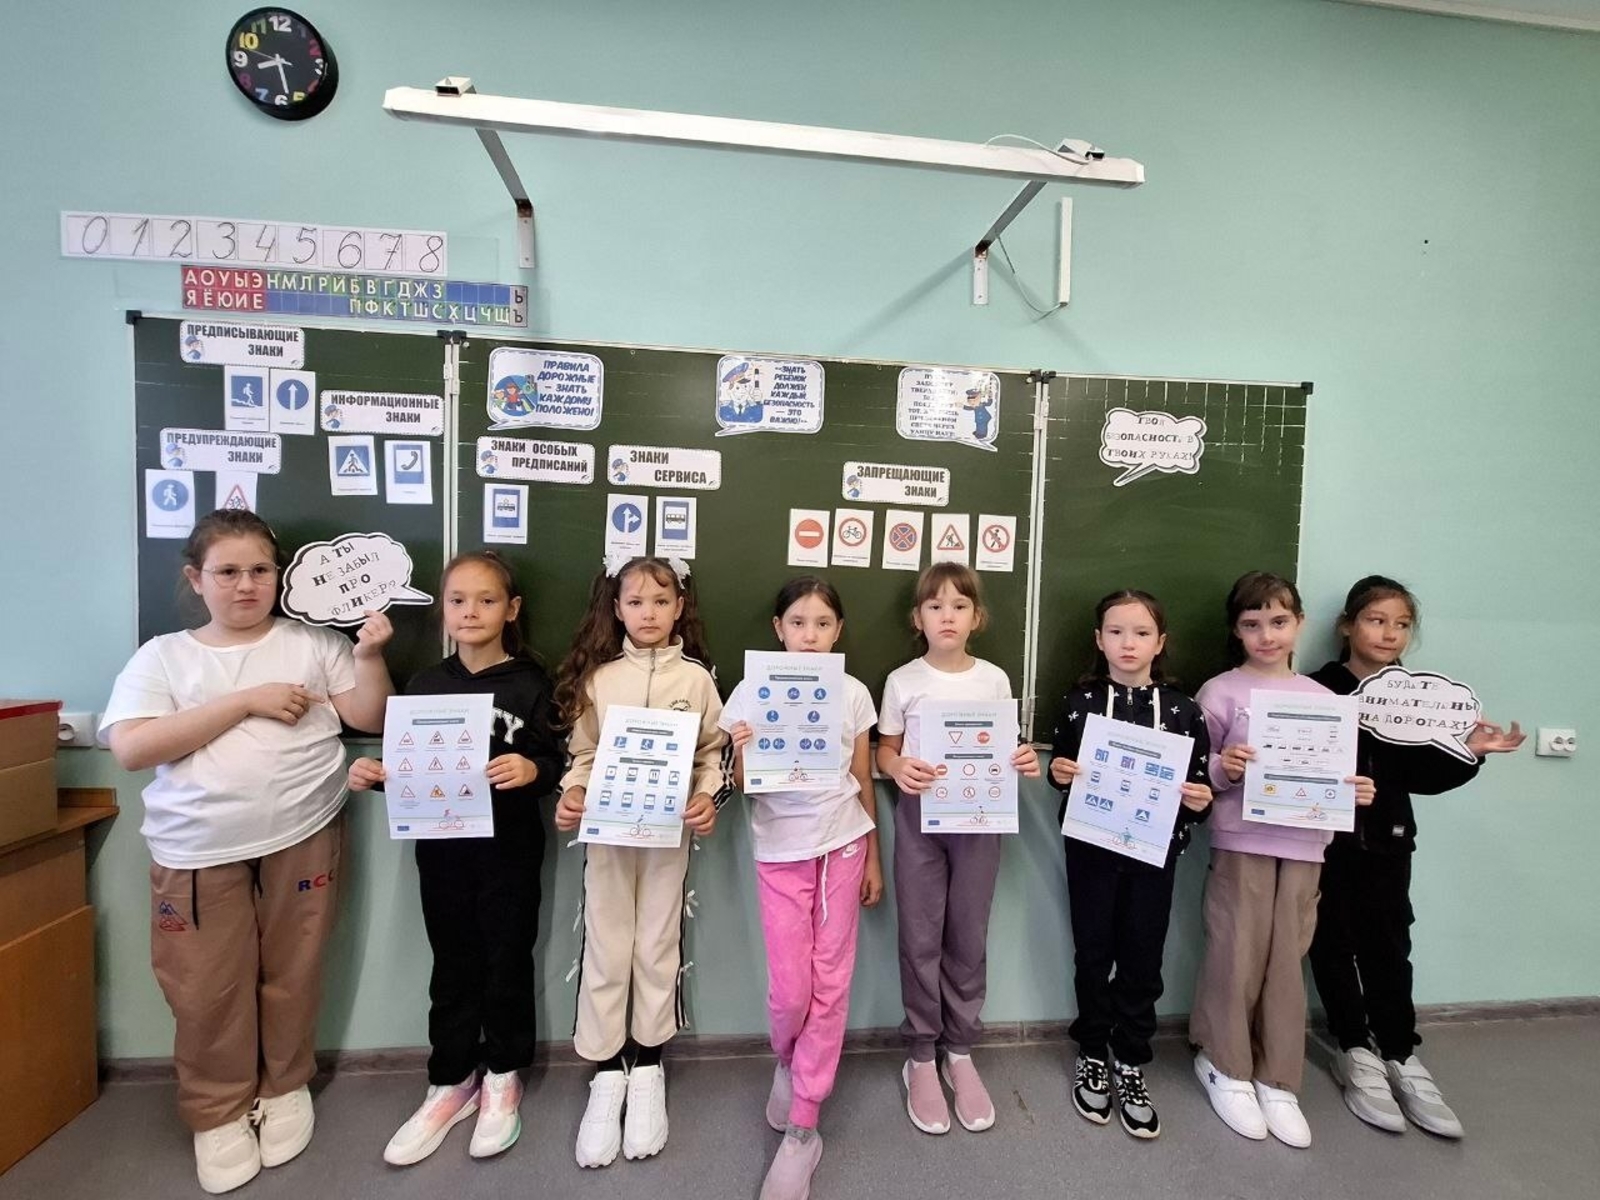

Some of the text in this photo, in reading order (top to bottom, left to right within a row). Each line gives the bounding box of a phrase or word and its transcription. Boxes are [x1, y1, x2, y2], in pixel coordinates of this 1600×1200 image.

[269, 15, 292, 33] 12
[239, 32, 259, 50] 10
[309, 39, 321, 57] 2
[233, 50, 248, 68] 9
[255, 87, 268, 101] 7
[274, 94, 288, 106] 6
[82, 216, 444, 273] 0 1 2 3 4 5 6 7 8
[187, 323, 299, 343] ПРЕДПИСЫВАЮЩИЕ
[248, 343, 284, 358] ЗНАКИ
[543, 360, 590, 372] ПРАВИЛА
[536, 371, 596, 384] ДОРОЖНЫЕ
[556, 384, 587, 394] ЗНАТЬ
[770, 390, 807, 400] КАЖДЫЙ
[331, 393, 440, 411] ИНФОРМАЦИОННЫЕ
[539, 393, 592, 405] КАЖДОМУ
[763, 399, 815, 409] БЕЗОПАСНОСТЬ
[385, 410, 421, 424] ЗНАКИ
[536, 403, 595, 416] ПОЛОЖЕНО!
[787, 409, 802, 417] ЭТО
[167, 432, 277, 449] ПРЕДУПРЕЖДАЮЩИЕ
[490, 439, 578, 457] ЗНАКИ ОСОБЫХ
[227, 449, 263, 464] ЗНАКИ
[630, 449, 670, 465] ЗНАКИ
[1107, 448, 1146, 459] ТВОИХ
[511, 456, 588, 473] ПРЕДПИСАНИЙ
[654, 469, 707, 485] СЕРВИСА
[857, 465, 946, 483] ЗАПРЕЩАЮЩИЕ
[904, 485, 938, 498] ЗНАКИ
[319, 542, 355, 566] А ТЫ
[311, 551, 380, 587] НЕ ЗАБЫЛ
[338, 573, 371, 595] ПРО
[331, 579, 398, 617] ФЛИКЕР?
[1359, 712, 1468, 730] НА ДОРОГАХ!
